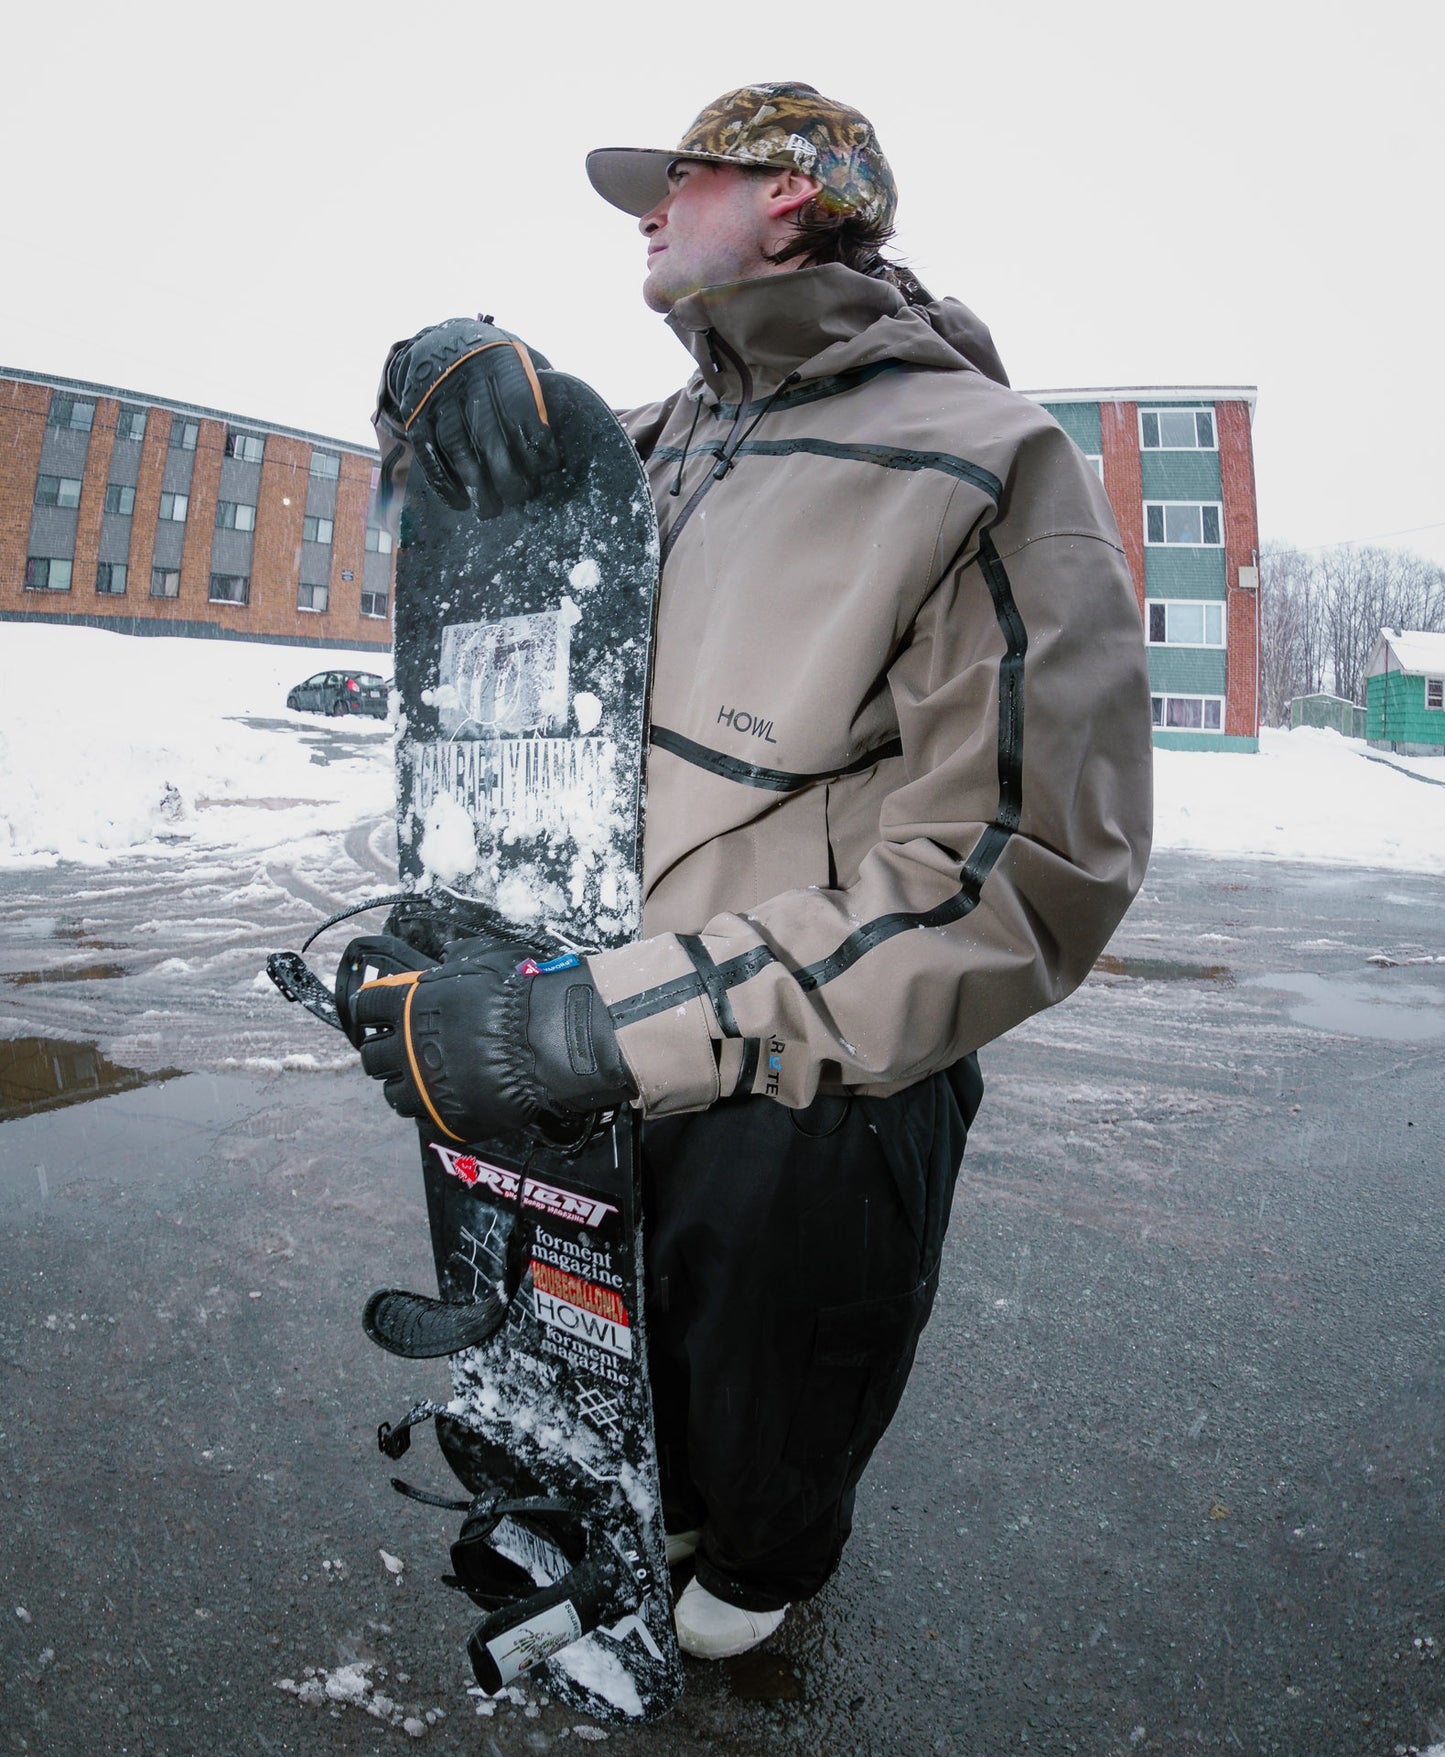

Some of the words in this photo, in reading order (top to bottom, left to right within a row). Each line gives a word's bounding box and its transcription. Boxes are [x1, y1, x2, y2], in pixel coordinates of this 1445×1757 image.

[717, 705, 777, 744] HOWL
[531, 1244, 623, 1288] magazine
[535, 1225, 612, 1269] torment
[537, 1293, 628, 1352] HOWL
[541, 1339, 630, 1386] magazine
